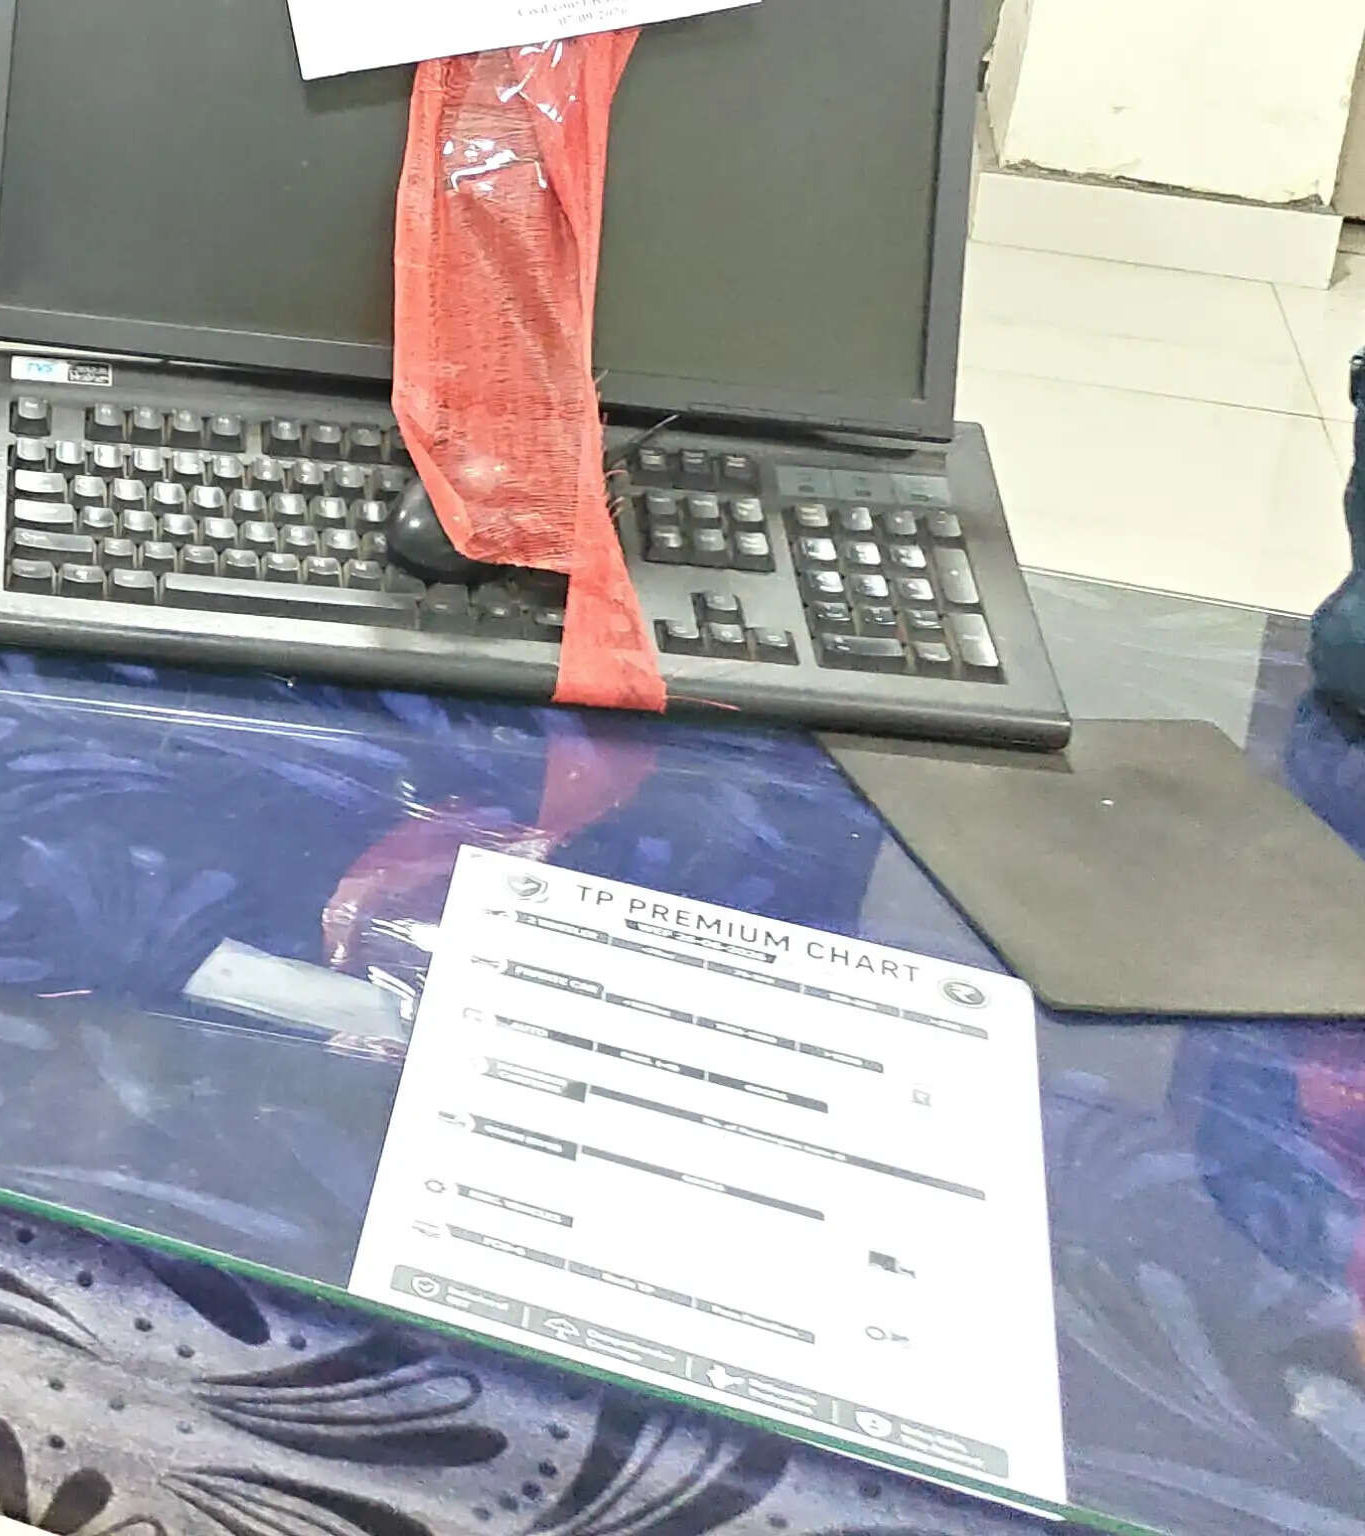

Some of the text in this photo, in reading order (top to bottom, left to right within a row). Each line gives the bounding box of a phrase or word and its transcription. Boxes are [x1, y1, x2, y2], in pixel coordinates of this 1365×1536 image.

[576, 884, 614, 906] TP
[628, 898, 790, 952] PREMIUM
[806, 940, 921, 982] CHART
